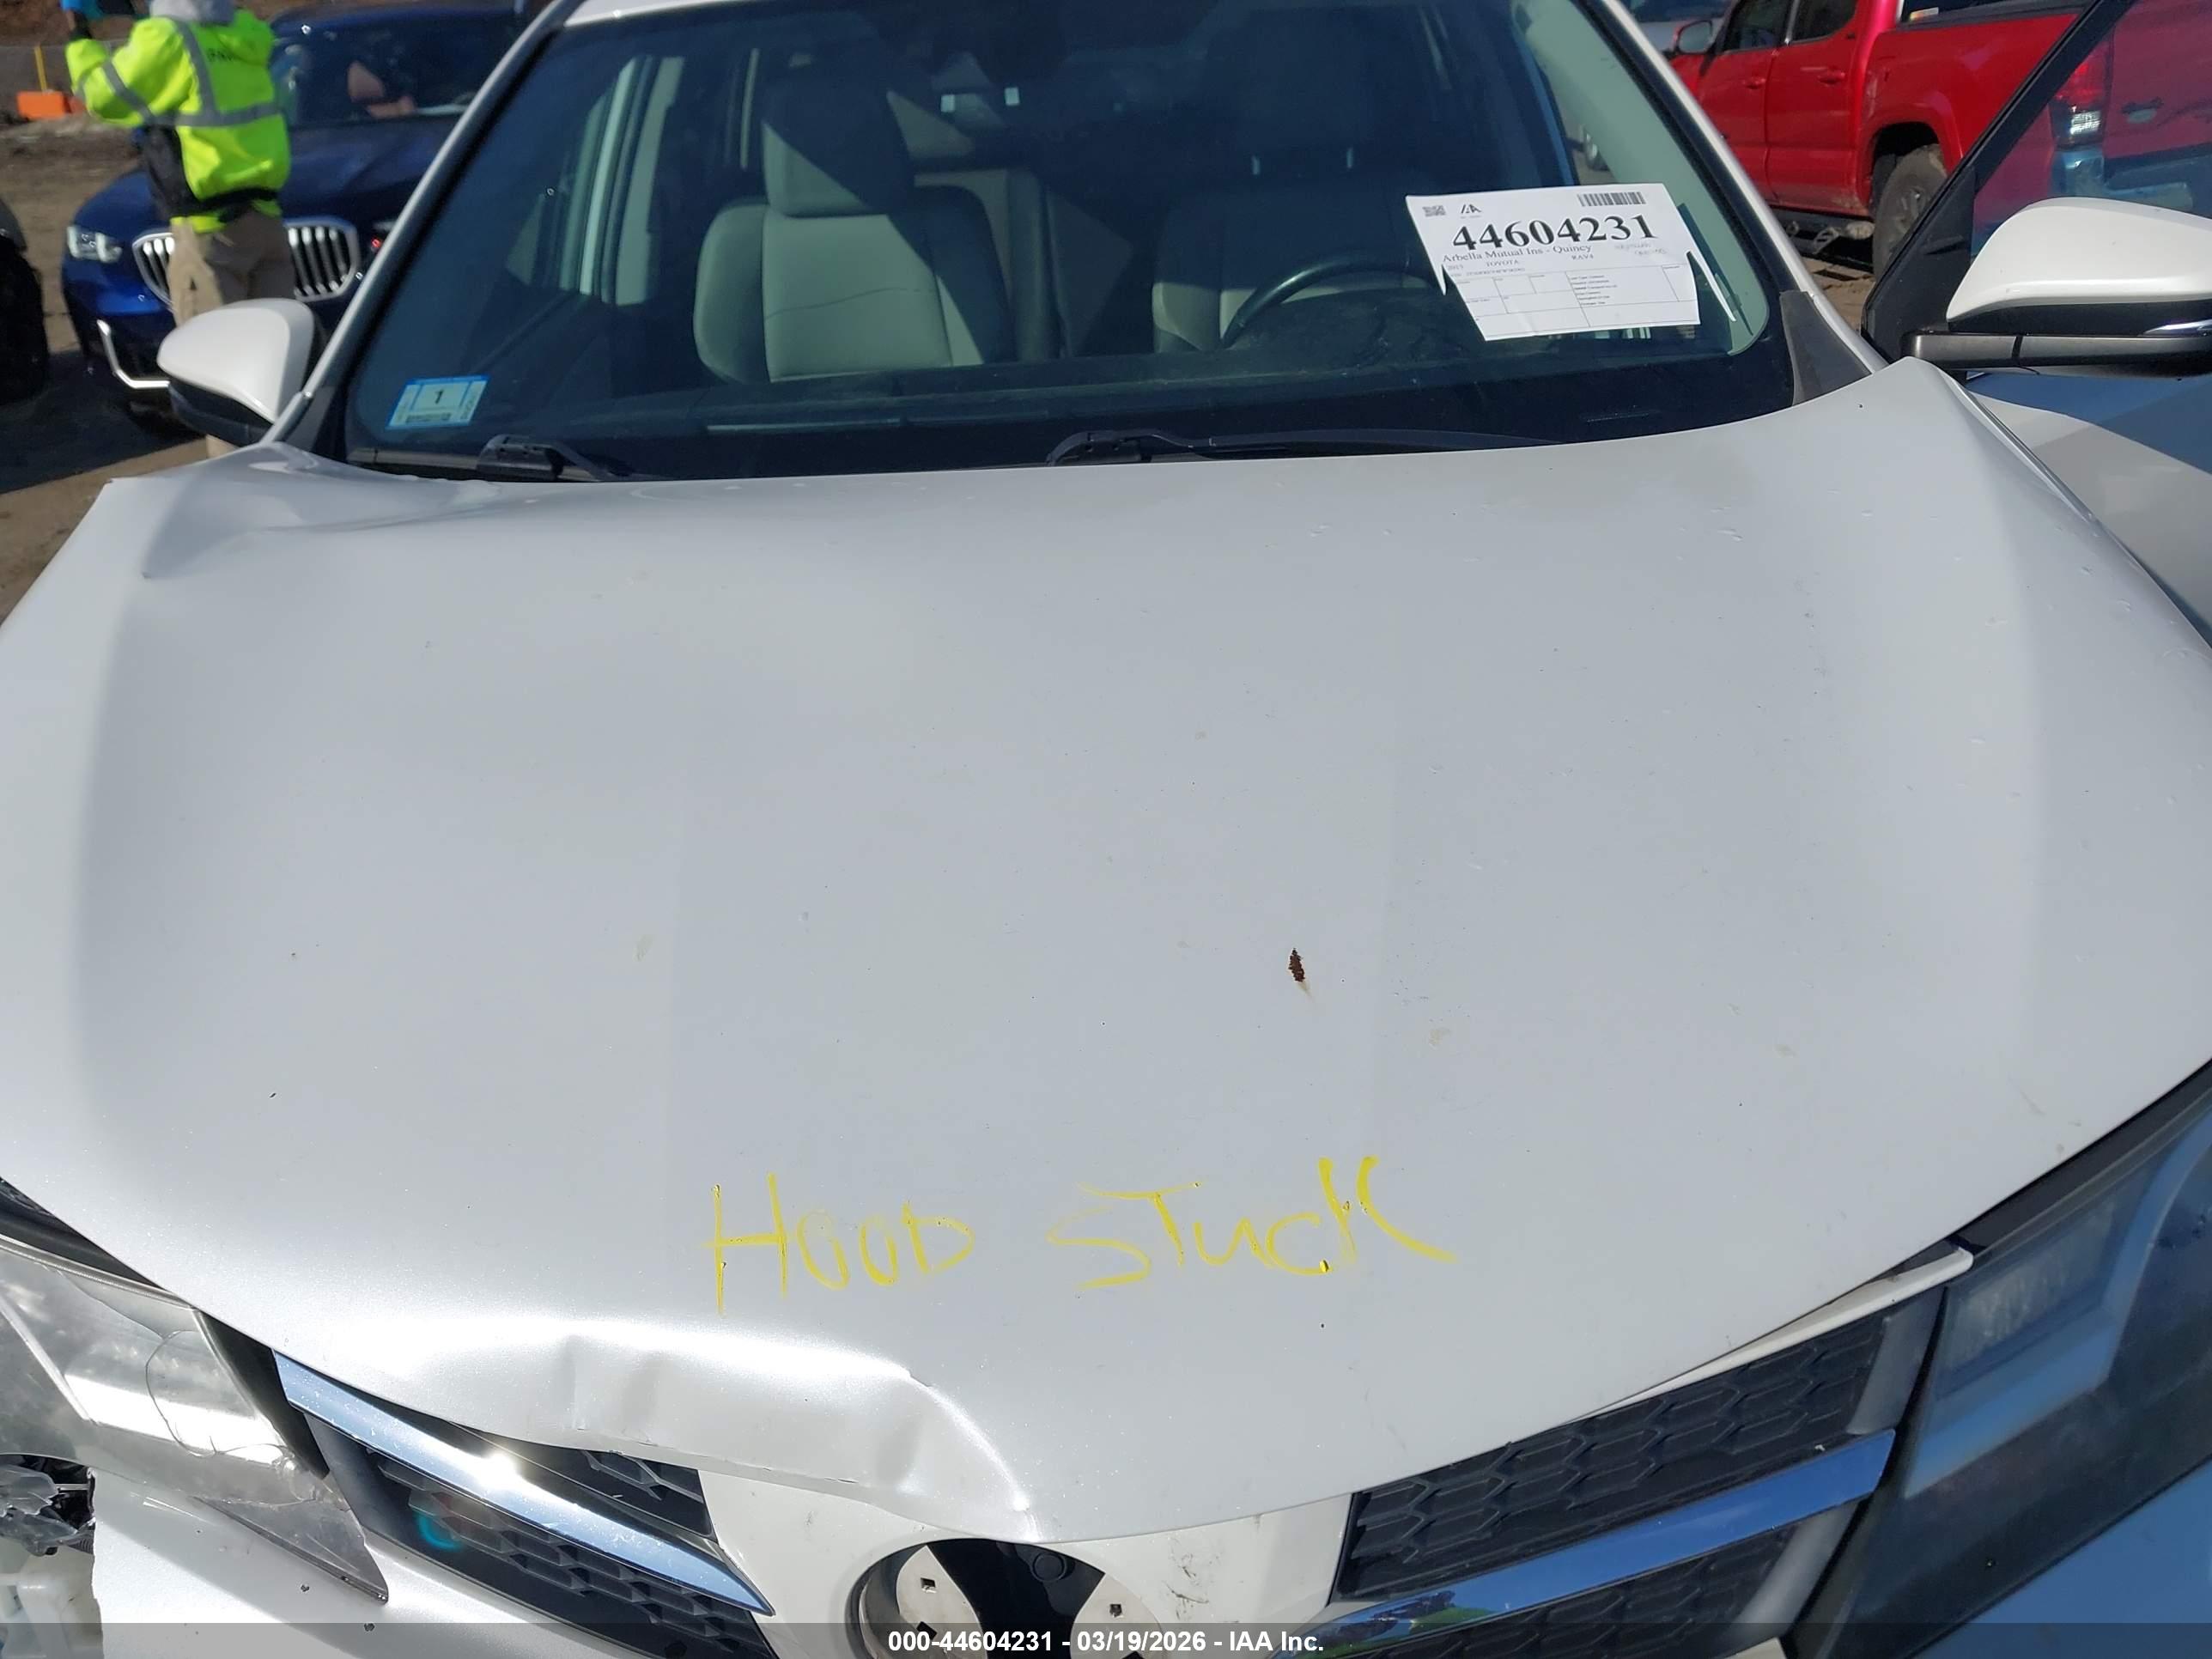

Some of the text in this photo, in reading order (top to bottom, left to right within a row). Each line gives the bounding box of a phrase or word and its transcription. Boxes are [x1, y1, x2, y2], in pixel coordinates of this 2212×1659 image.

[1453, 215, 1657, 251] 44604231
[1443, 252, 1483, 263] Arbella
[1485, 248, 1523, 258] Mutual
[1527, 246, 1544, 256] Ins
[1553, 245, 1593, 255] Quincy
